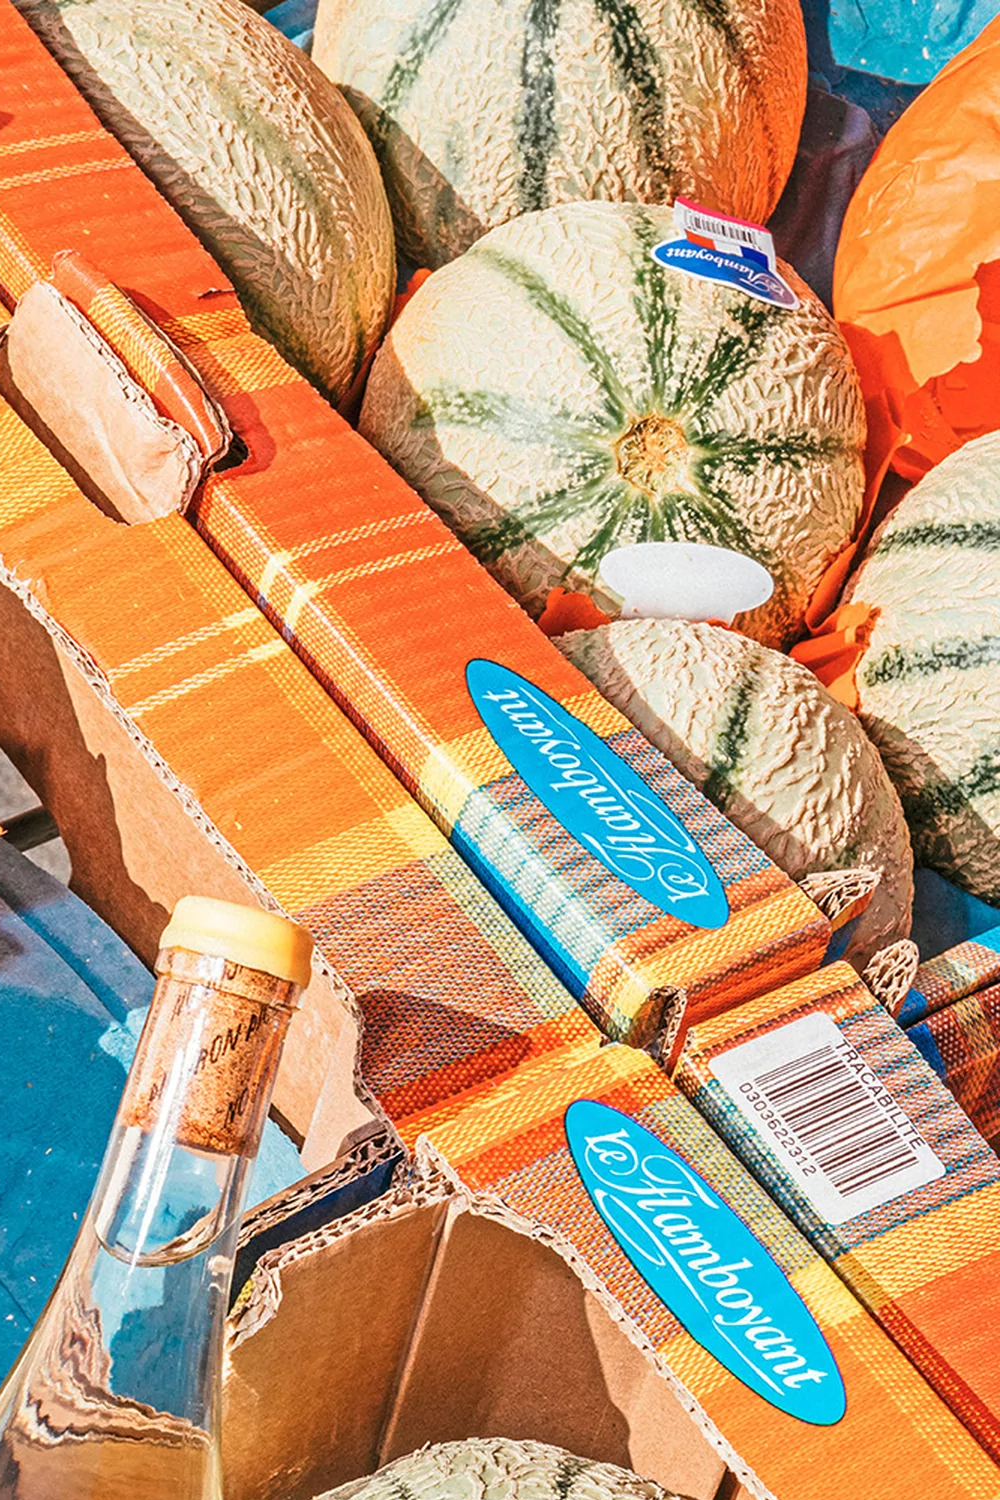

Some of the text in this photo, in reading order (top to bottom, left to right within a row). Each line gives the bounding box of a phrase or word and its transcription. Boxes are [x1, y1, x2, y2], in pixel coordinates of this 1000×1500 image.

[482, 687, 696, 881] Flamboyant
[739, 1082, 817, 1177] 0303622312
[836, 1040, 926, 1151] TRACABILITE
[595, 1154, 829, 1396] Flamboyant
